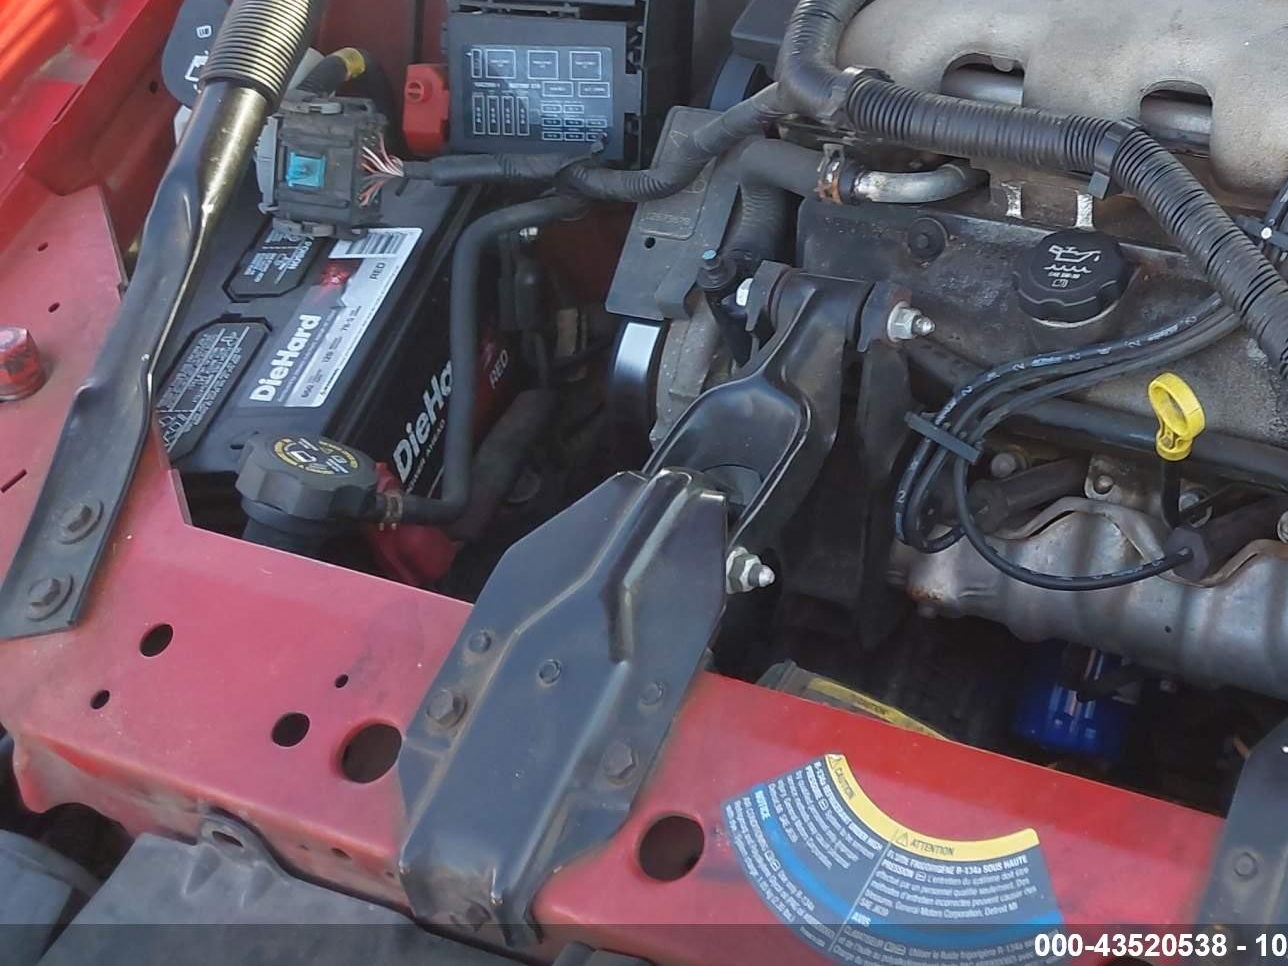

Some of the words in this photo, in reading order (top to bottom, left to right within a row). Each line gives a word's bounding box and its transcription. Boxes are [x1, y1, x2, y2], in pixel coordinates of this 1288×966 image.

[369, 262, 387, 281] RED
[249, 314, 322, 402] DieHard
[392, 360, 453, 483] DieHa
[834, 766, 855, 801] CAUTION
[754, 789, 771, 822] NOTICE
[909, 839, 955, 855] ATTENTION
